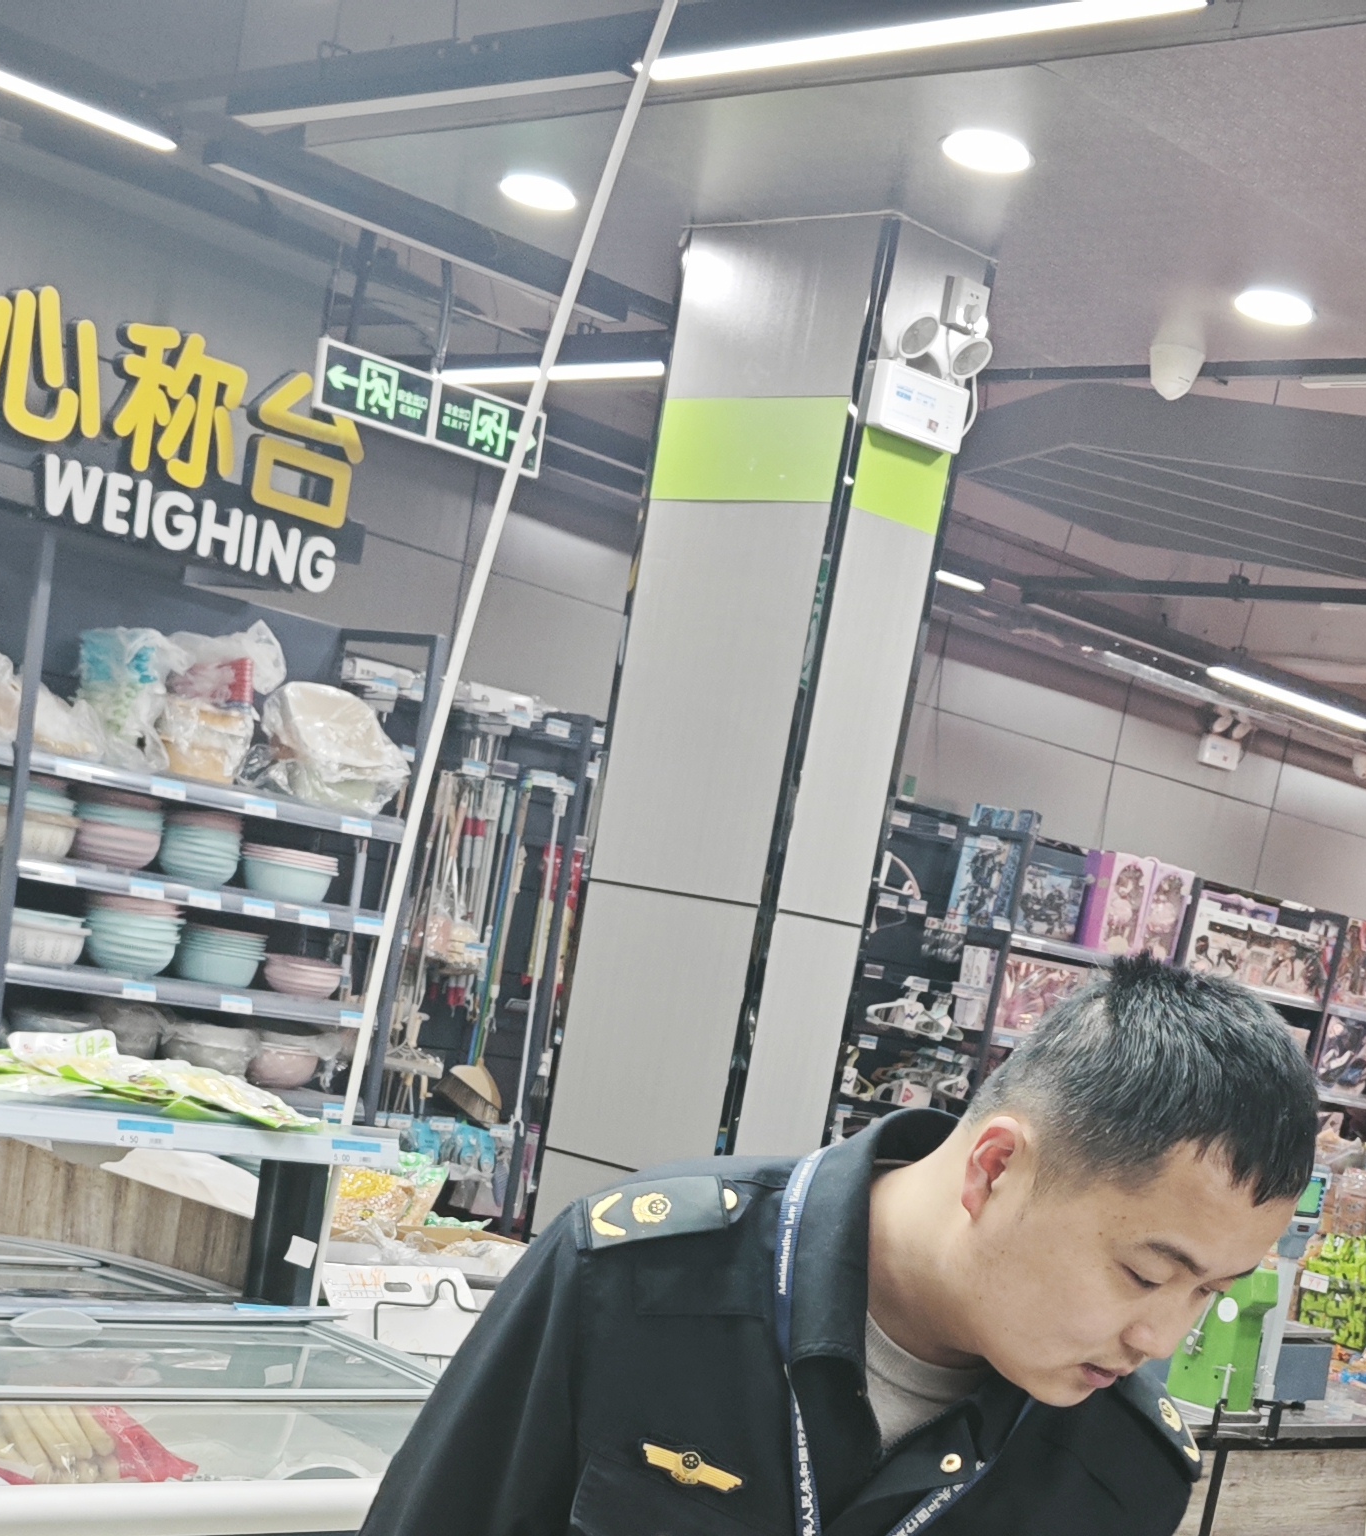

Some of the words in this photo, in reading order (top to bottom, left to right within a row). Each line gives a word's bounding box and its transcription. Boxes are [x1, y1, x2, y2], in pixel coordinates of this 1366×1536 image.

[399, 404, 423, 421] EXIT
[442, 416, 470, 432] EXIT
[44, 452, 336, 594] WEIGHING
